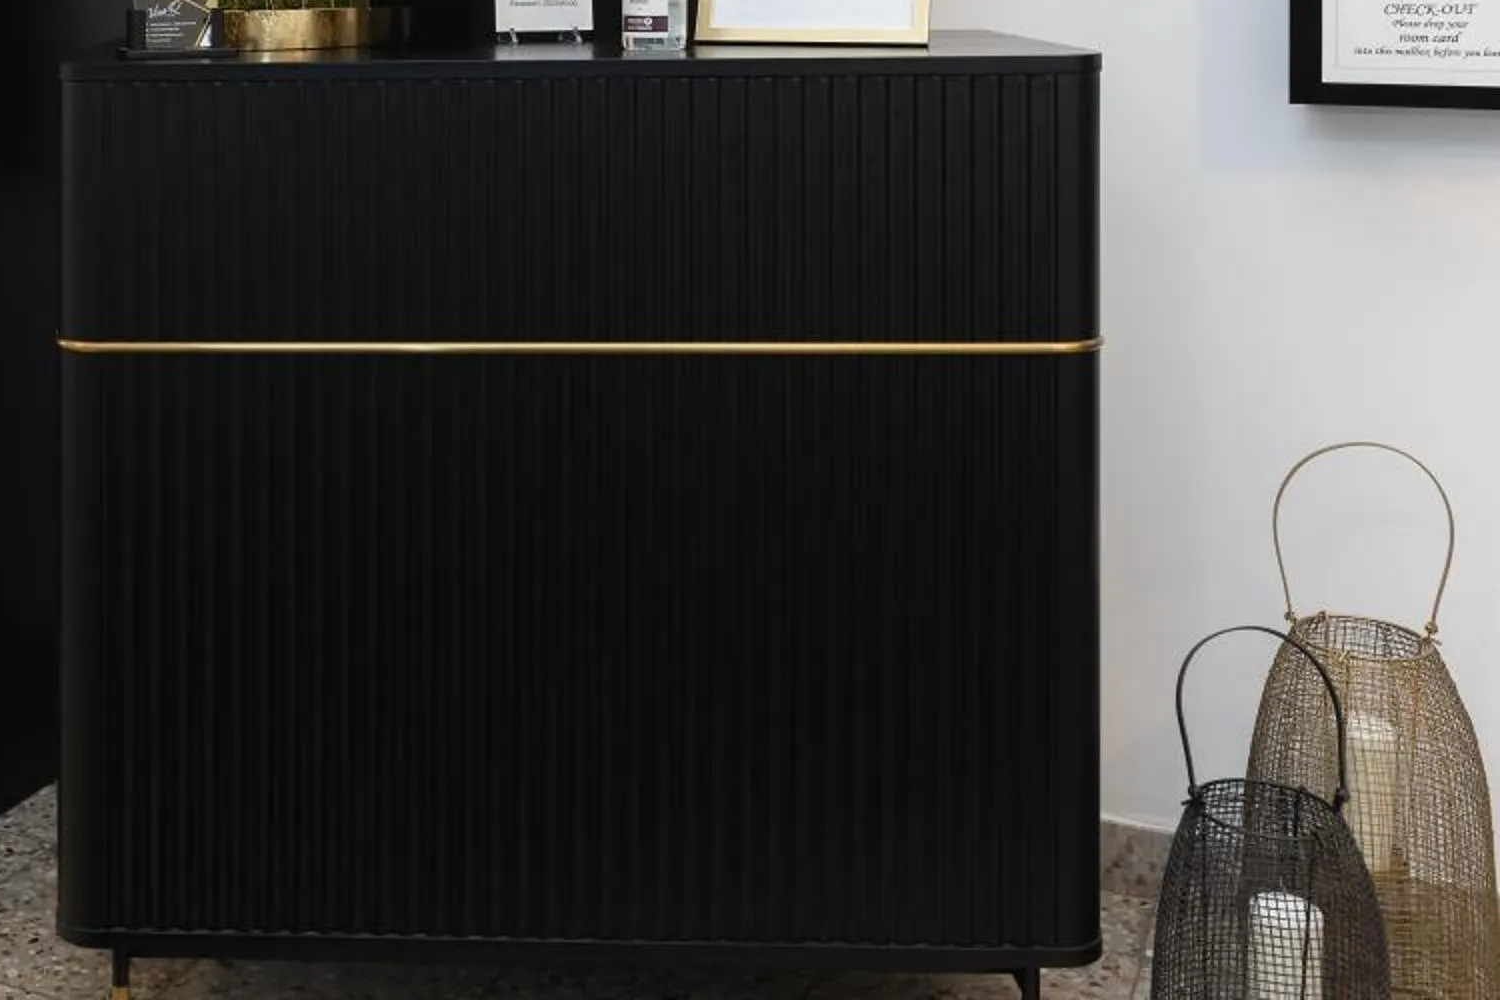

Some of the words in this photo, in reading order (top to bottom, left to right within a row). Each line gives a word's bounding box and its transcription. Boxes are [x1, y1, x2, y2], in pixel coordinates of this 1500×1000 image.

[1383, 3, 1479, 16] CHECK-OUT
[1398, 34, 1429, 43] room
[1432, 31, 1463, 43] card
